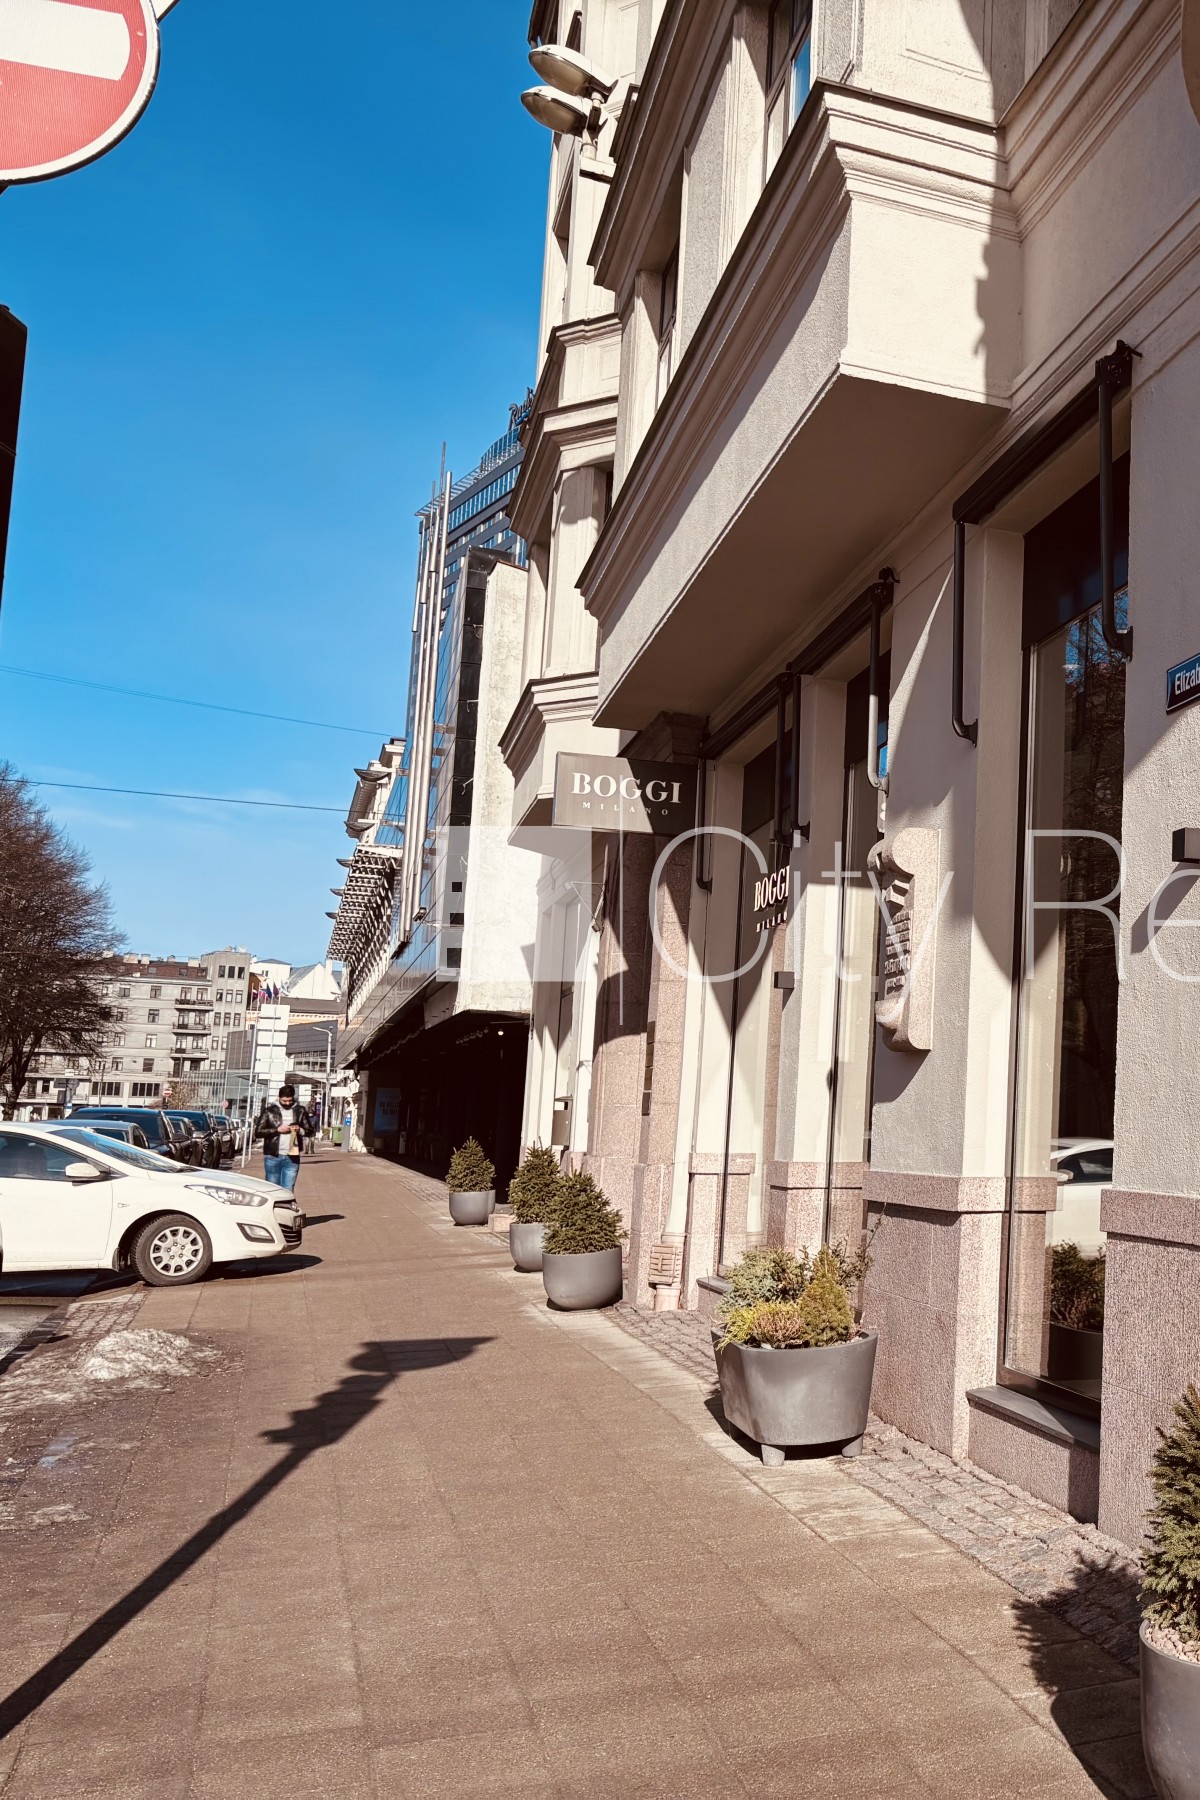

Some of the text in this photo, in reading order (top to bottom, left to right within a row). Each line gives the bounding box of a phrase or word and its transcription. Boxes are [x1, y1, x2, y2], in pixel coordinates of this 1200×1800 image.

[570, 772, 683, 804] BOGGI
[582, 801, 669, 816] MILANO
[754, 865, 790, 912] BOGGI
